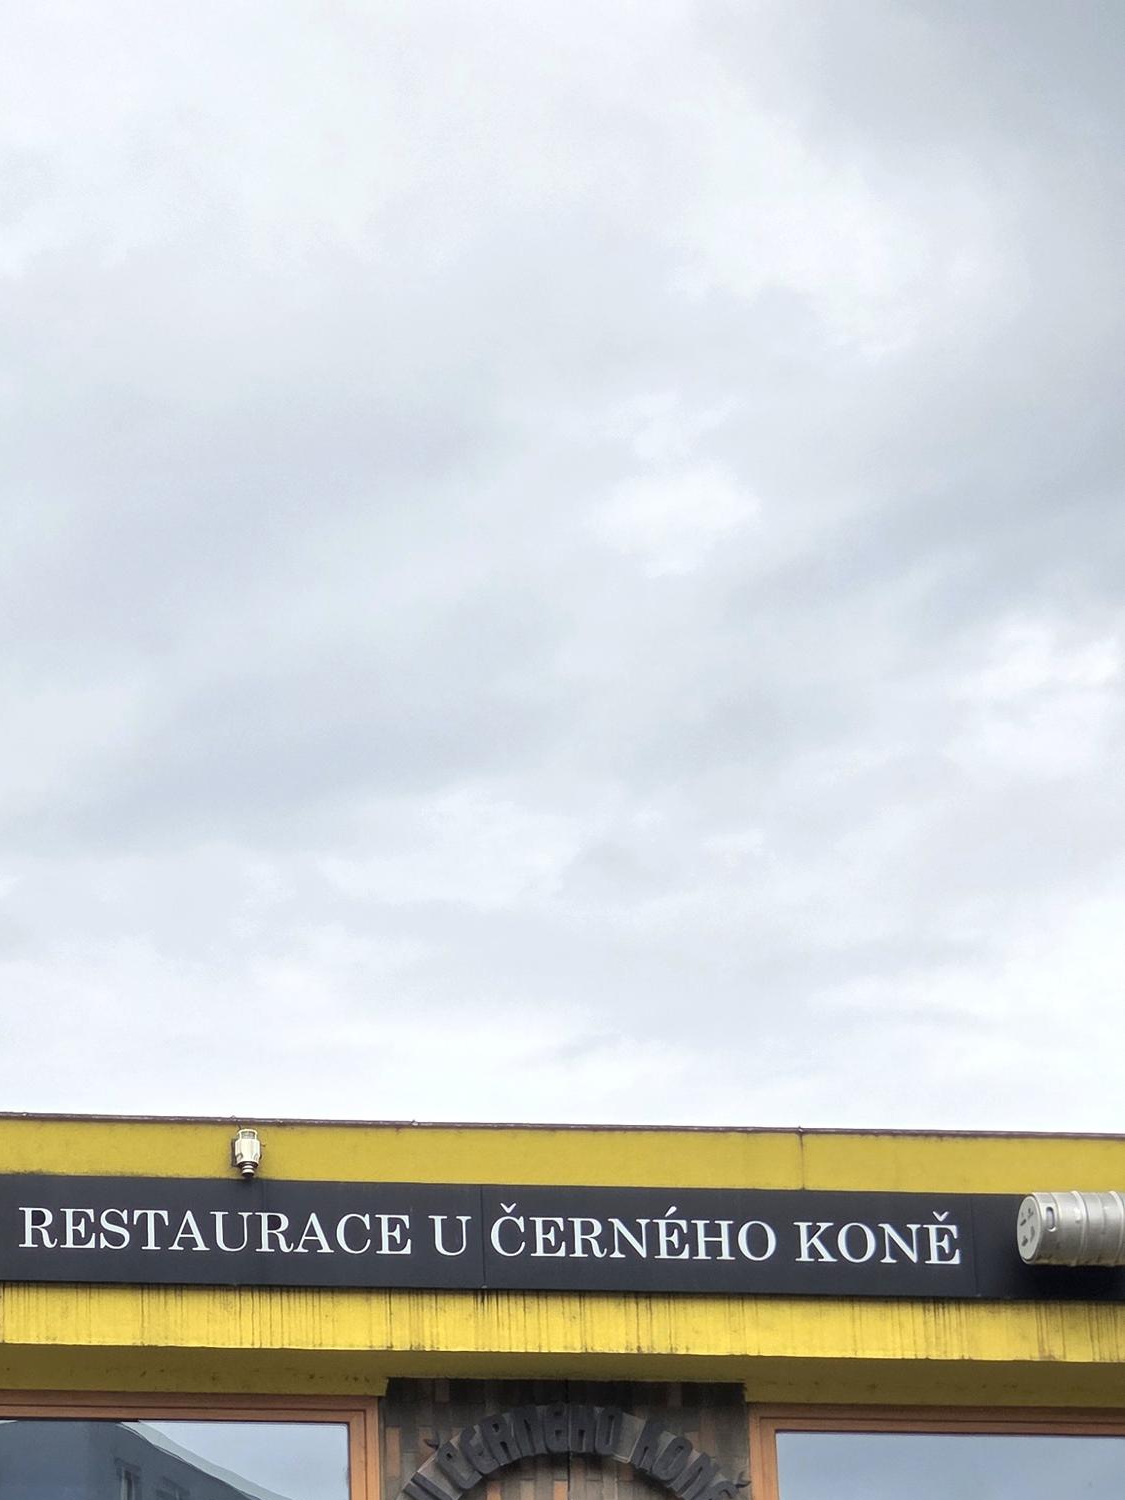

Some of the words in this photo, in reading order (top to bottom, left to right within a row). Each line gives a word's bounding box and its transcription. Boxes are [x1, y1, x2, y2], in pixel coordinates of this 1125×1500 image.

[18, 1206, 412, 1256] RESTAURACE
[428, 1215, 473, 1257] U
[489, 1202, 777, 1262] ČERNÉHO
[794, 1210, 961, 1265] KONĚ
